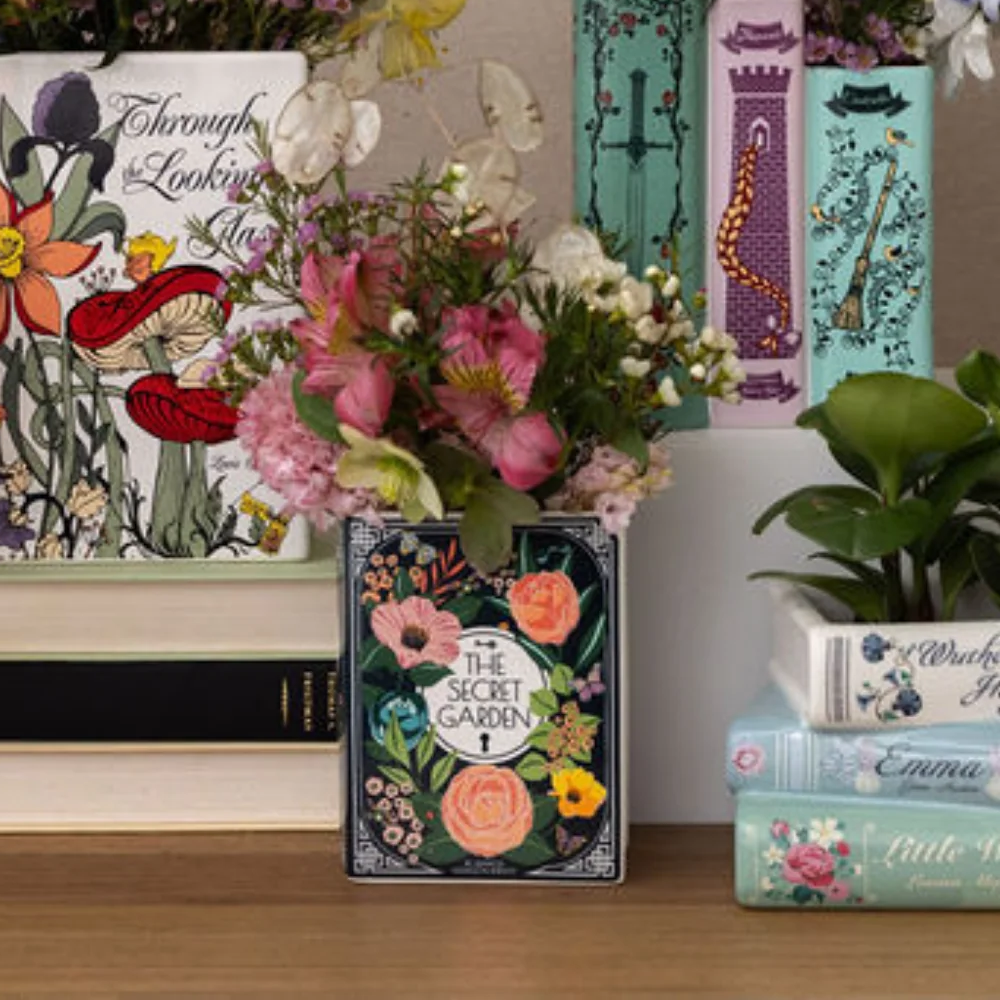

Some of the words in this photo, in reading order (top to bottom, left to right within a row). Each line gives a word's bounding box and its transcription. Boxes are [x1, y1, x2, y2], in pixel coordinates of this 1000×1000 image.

[107, 91, 267, 150] Through
[464, 652, 506, 675] THE
[446, 678, 523, 702] SECRET
[436, 704, 532, 729] GARDEN
[874, 742, 985, 778] Emma
[880, 834, 964, 869] Little
